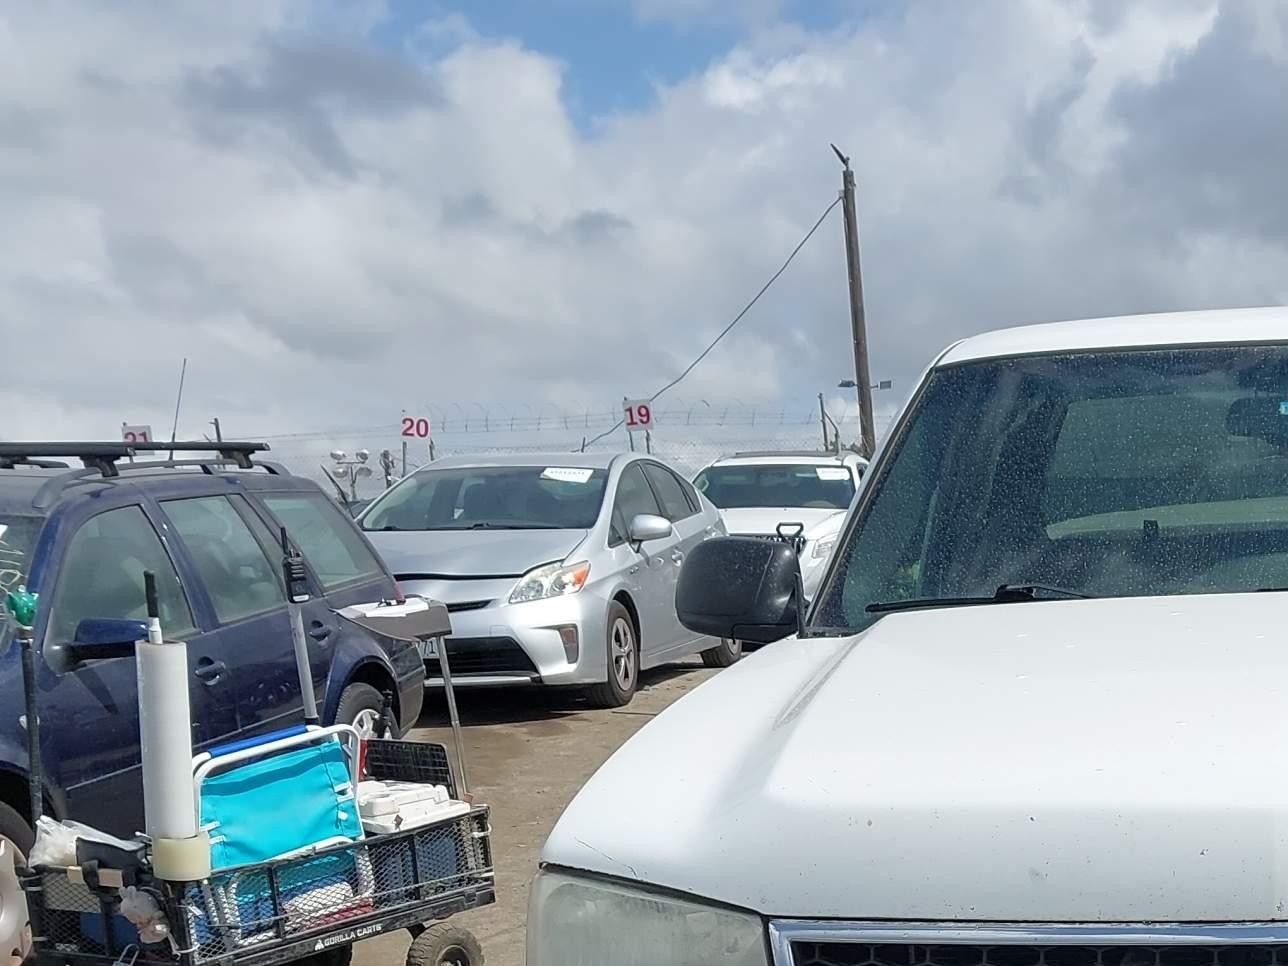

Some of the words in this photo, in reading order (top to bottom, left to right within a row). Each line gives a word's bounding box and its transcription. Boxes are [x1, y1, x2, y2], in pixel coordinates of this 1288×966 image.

[624, 405, 650, 426] 19
[402, 418, 429, 438] 20
[324, 931, 356, 946] GORILLA
[356, 924, 383, 936] CARTS
